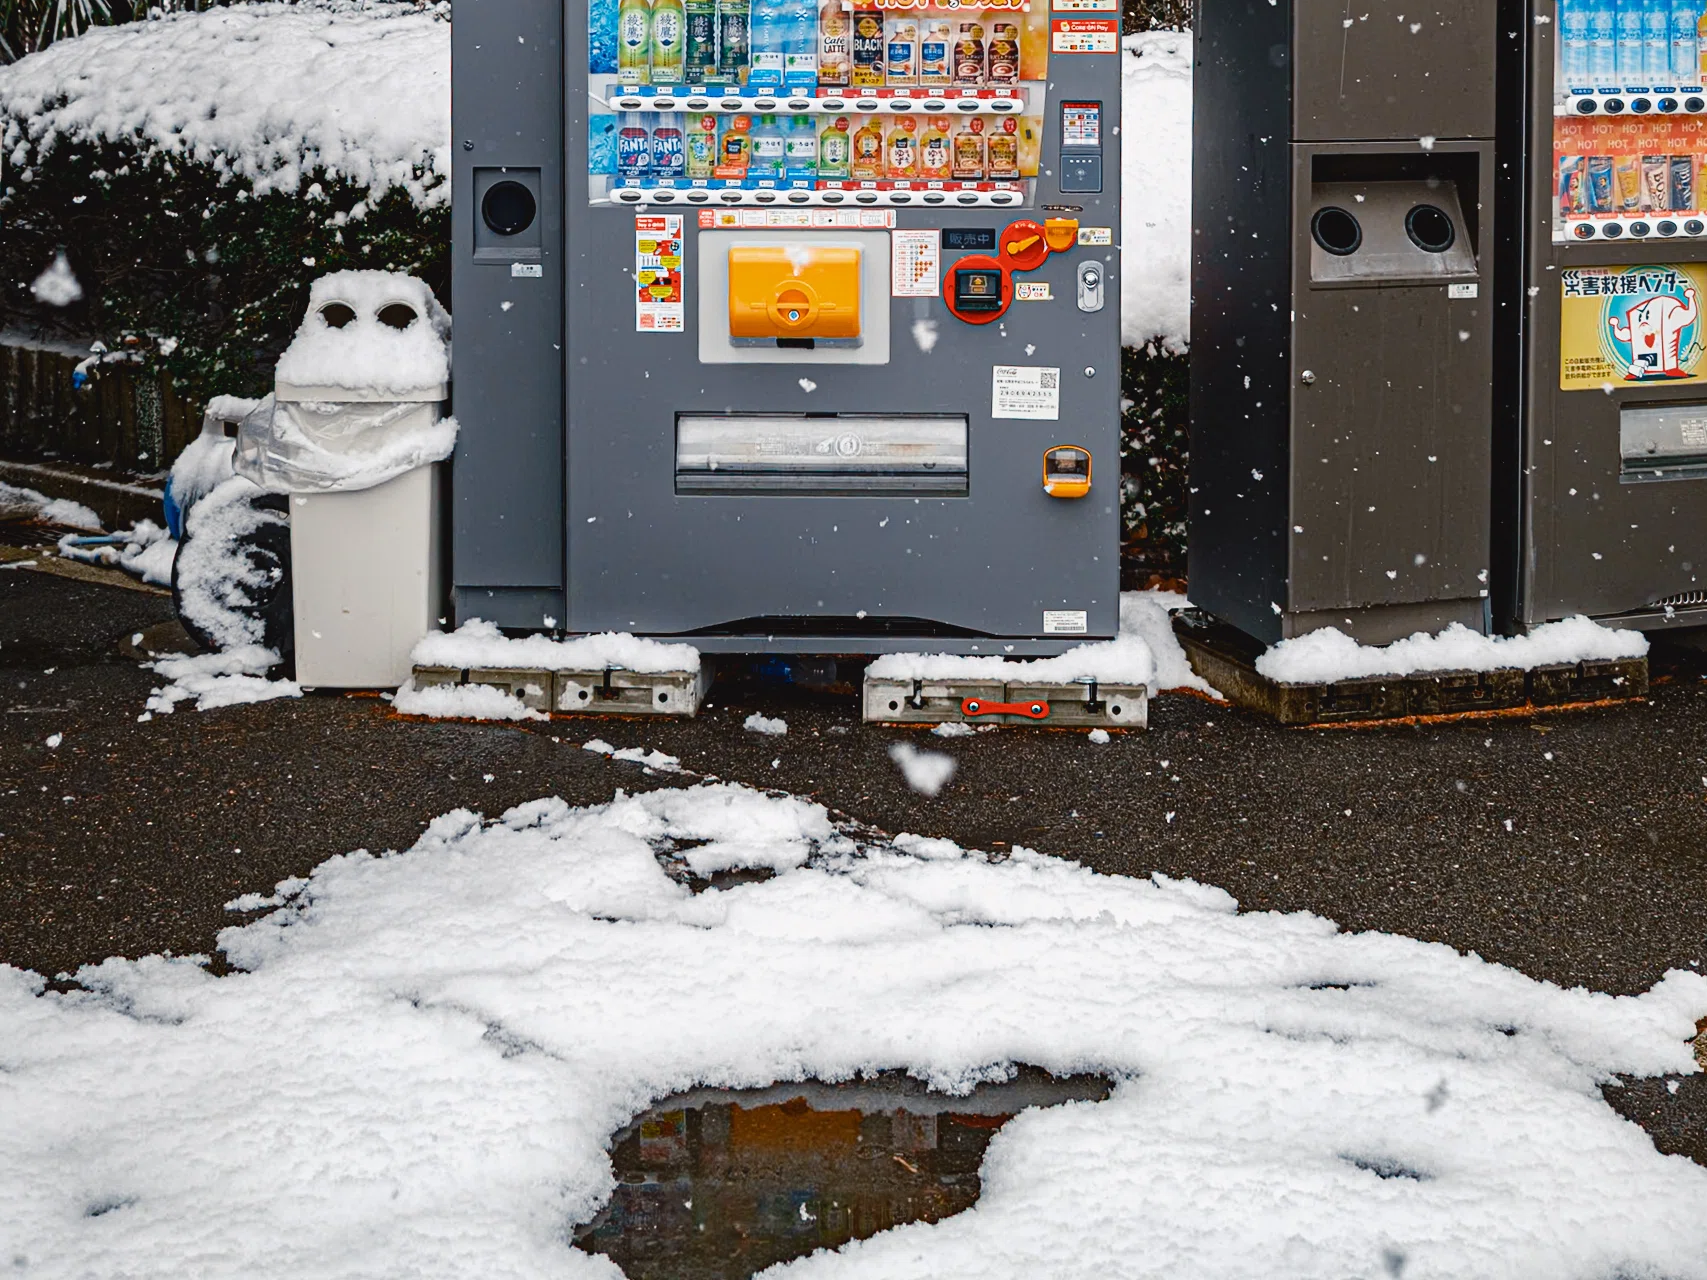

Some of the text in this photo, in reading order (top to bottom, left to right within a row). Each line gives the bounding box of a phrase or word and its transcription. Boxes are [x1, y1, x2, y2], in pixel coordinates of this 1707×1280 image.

[627, 14, 640, 39] 綾鷹
[660, 14, 673, 39] 綾鷹
[1096, 24, 1109, 32] Pay
[824, 36, 845, 45] Café
[854, 38, 883, 51] BLACK
[823, 45, 845, 54] LATTE
[1561, 125, 1583, 135] HOT
[1592, 124, 1614, 134] HOT
[1622, 124, 1644, 134] HOT
[1652, 123, 1673, 133] HOT
[1553, 137, 1707, 150] OT HOT HOT HOT HOT HO
[1654, 171, 1666, 209] BOSS
[949, 232, 990, 245] 販売中
[1561, 270, 1689, 297] 災害救援ベンダー
